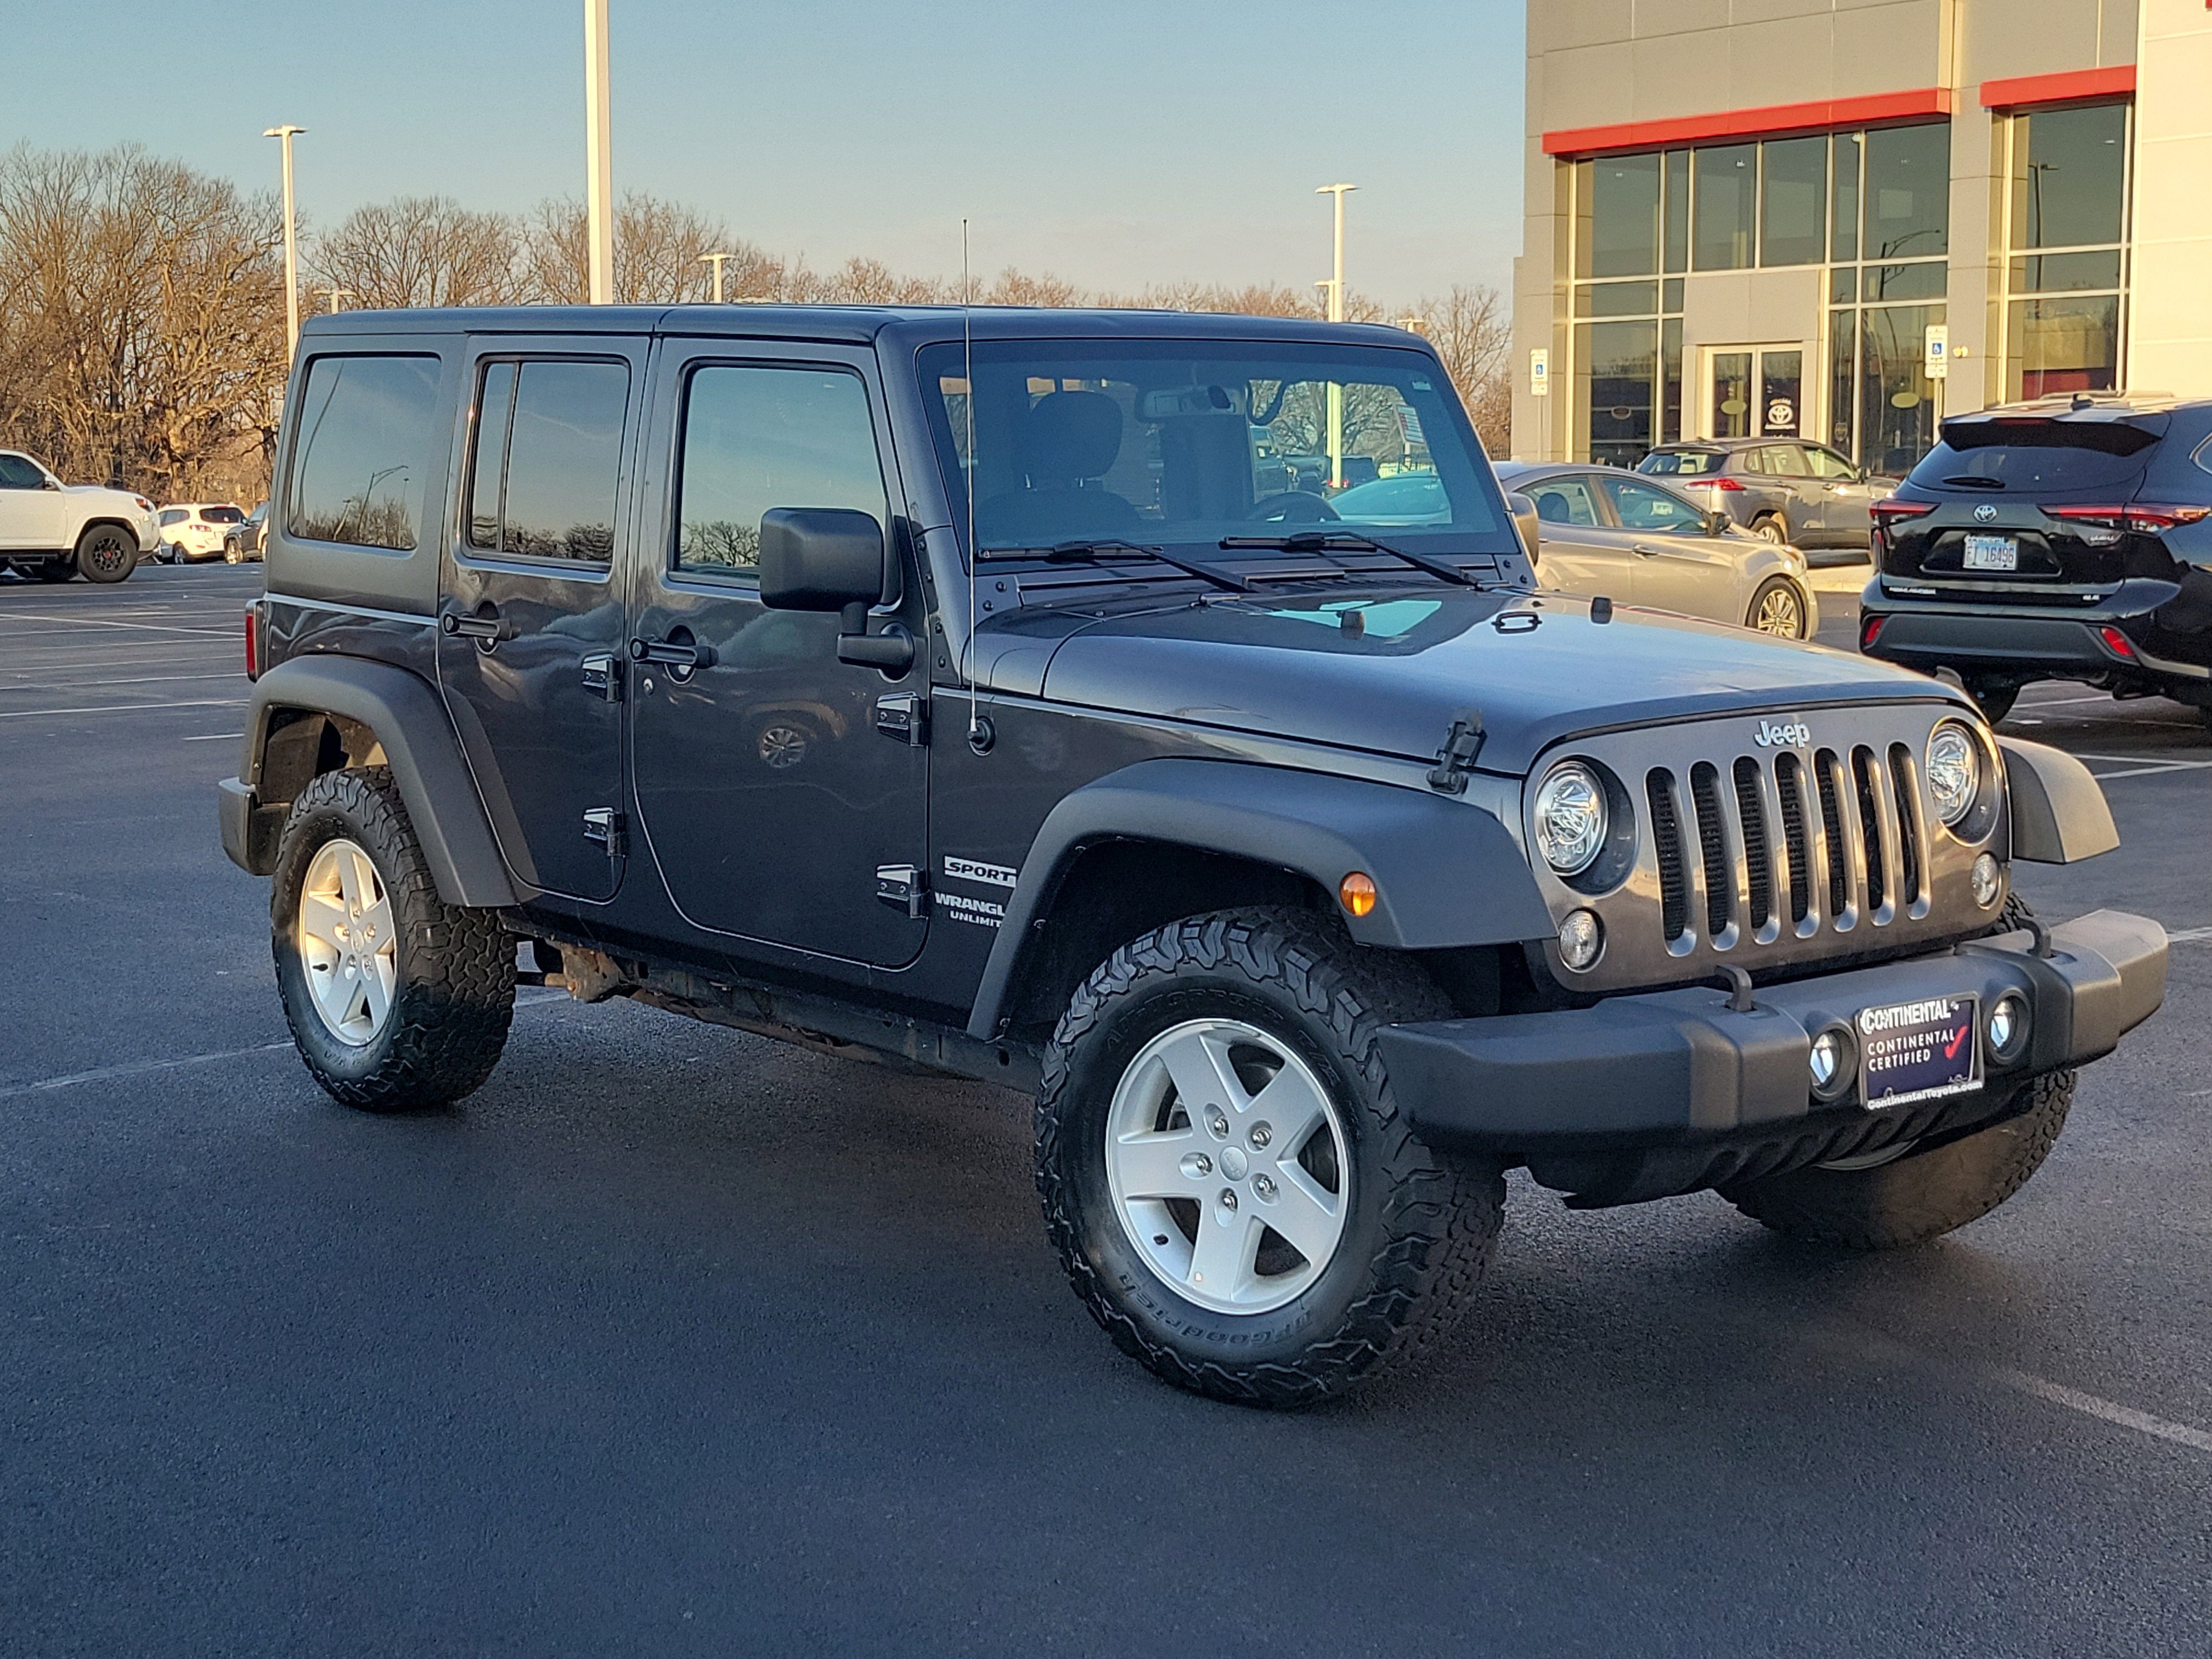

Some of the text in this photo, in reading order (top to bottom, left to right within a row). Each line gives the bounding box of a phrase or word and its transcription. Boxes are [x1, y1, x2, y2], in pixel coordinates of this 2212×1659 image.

[1754, 720, 1810, 748] Jeep
[945, 861, 1017, 882] SPORT
[934, 891, 1005, 916] WRANGL
[950, 910, 1003, 928] UNLIMIT
[1859, 998, 1951, 1035] CONTINENTAL
[1867, 1028, 1955, 1056] CONTINENTAL
[1868, 1049, 1931, 1072] CERTIFIED
[1867, 1081, 1983, 1110] ContinentalToyota.com
